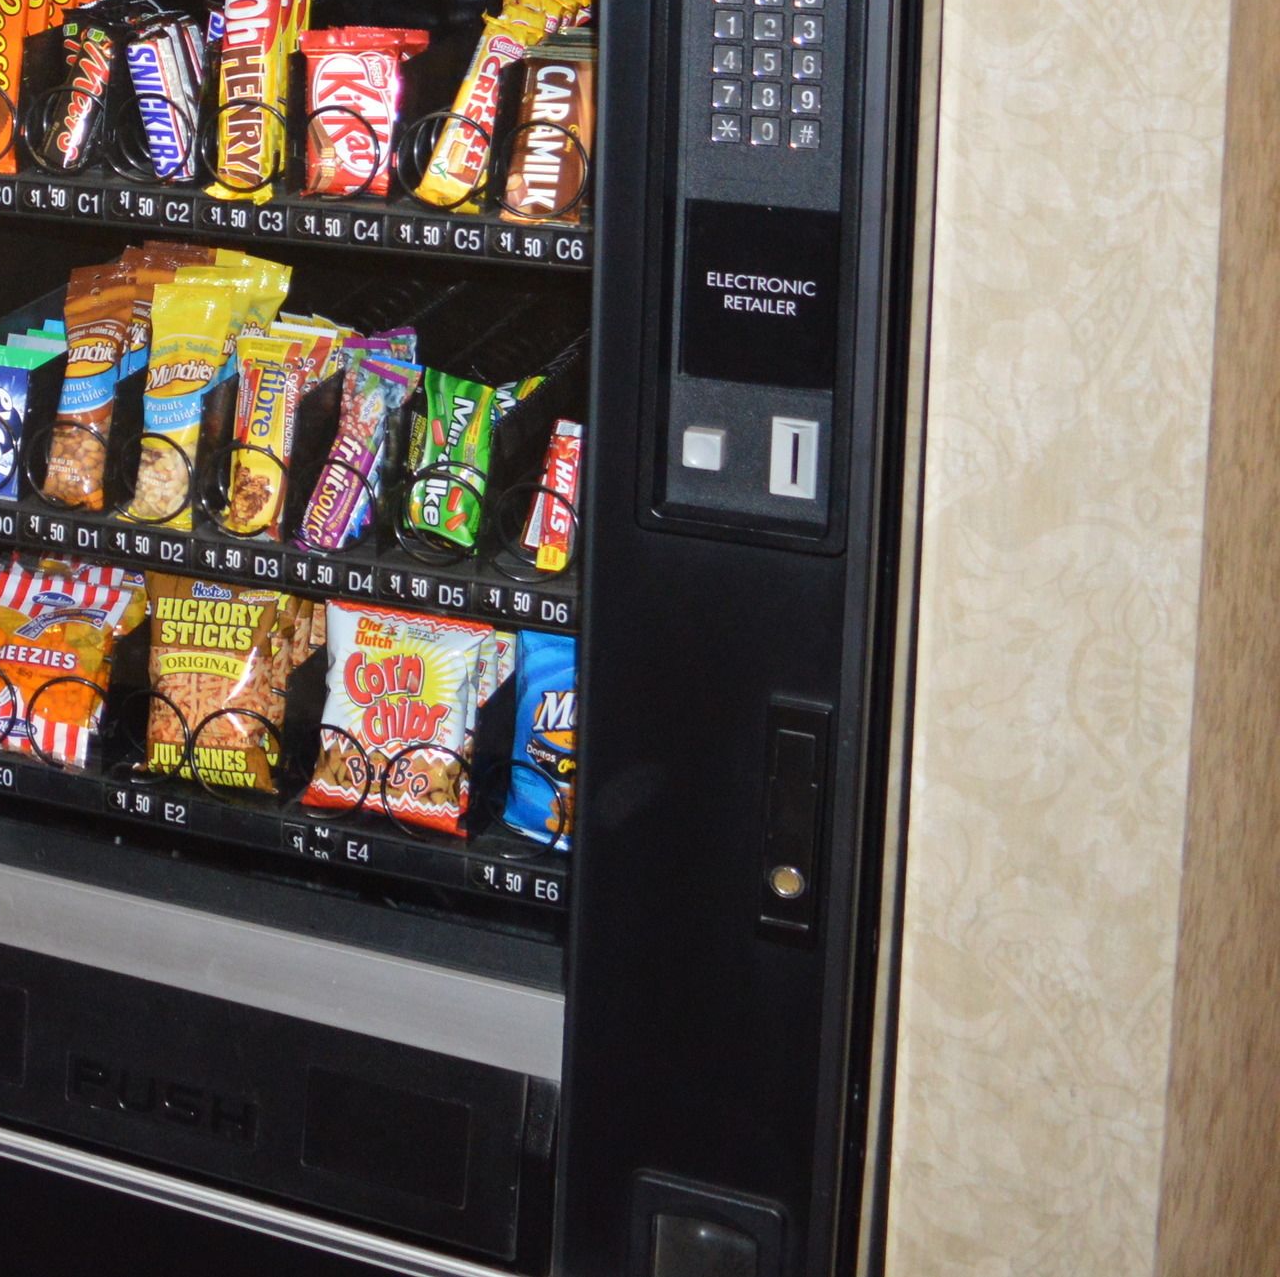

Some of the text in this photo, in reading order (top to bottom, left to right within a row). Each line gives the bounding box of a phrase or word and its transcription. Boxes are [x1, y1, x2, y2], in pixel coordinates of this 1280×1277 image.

[763, 19, 816, 40] 2 3
[723, 51, 815, 75] 4 5 6
[126, 43, 177, 180] SNICKERS
[722, 85, 815, 110] 7 8 9
[520, 64, 576, 211] CARAMILK
[30, 186, 99, 214] $1.50 C1
[119, 191, 190, 223] $1.50 C2
[210, 206, 284, 232] $1.50 C3
[304, 215, 380, 242] $1.50 C4
[399, 222, 481, 251] $1.50 C5
[500, 232, 584, 261] $1.50 C6
[706, 271, 817, 297] ELECTRONIC
[723, 294, 797, 316] RETAILER
[144, 359, 215, 393] Munchies
[145, 400, 185, 412] Peanuts
[152, 404, 203, 426] Arachides
[283, 411, 295, 457] TENDRES
[29, 514, 99, 549] $1.50 D1
[115, 531, 185, 562] $1.50 D2
[205, 549, 279, 577] $1.50 D3
[192, 581, 232, 600] Hostess
[296, 563, 374, 594] $1.50 D4
[390, 575, 465, 608] $1.50 D5
[156, 597, 265, 628] HICKORY
[488, 588, 569, 623] $1.50 D6
[161, 620, 253, 651] STICKS
[357, 616, 382, 631] Old
[355, 630, 393, 650] Dutch
[166, 655, 241, 676] ORIGINAL
[344, 651, 425, 708] Corn
[526, 744, 557, 763] Doritos
[116, 791, 186, 825] $1.50 E2
[346, 840, 370, 862] E4
[483, 866, 559, 902] $1.50 E6
[73, 1057, 258, 1147] PUSH
